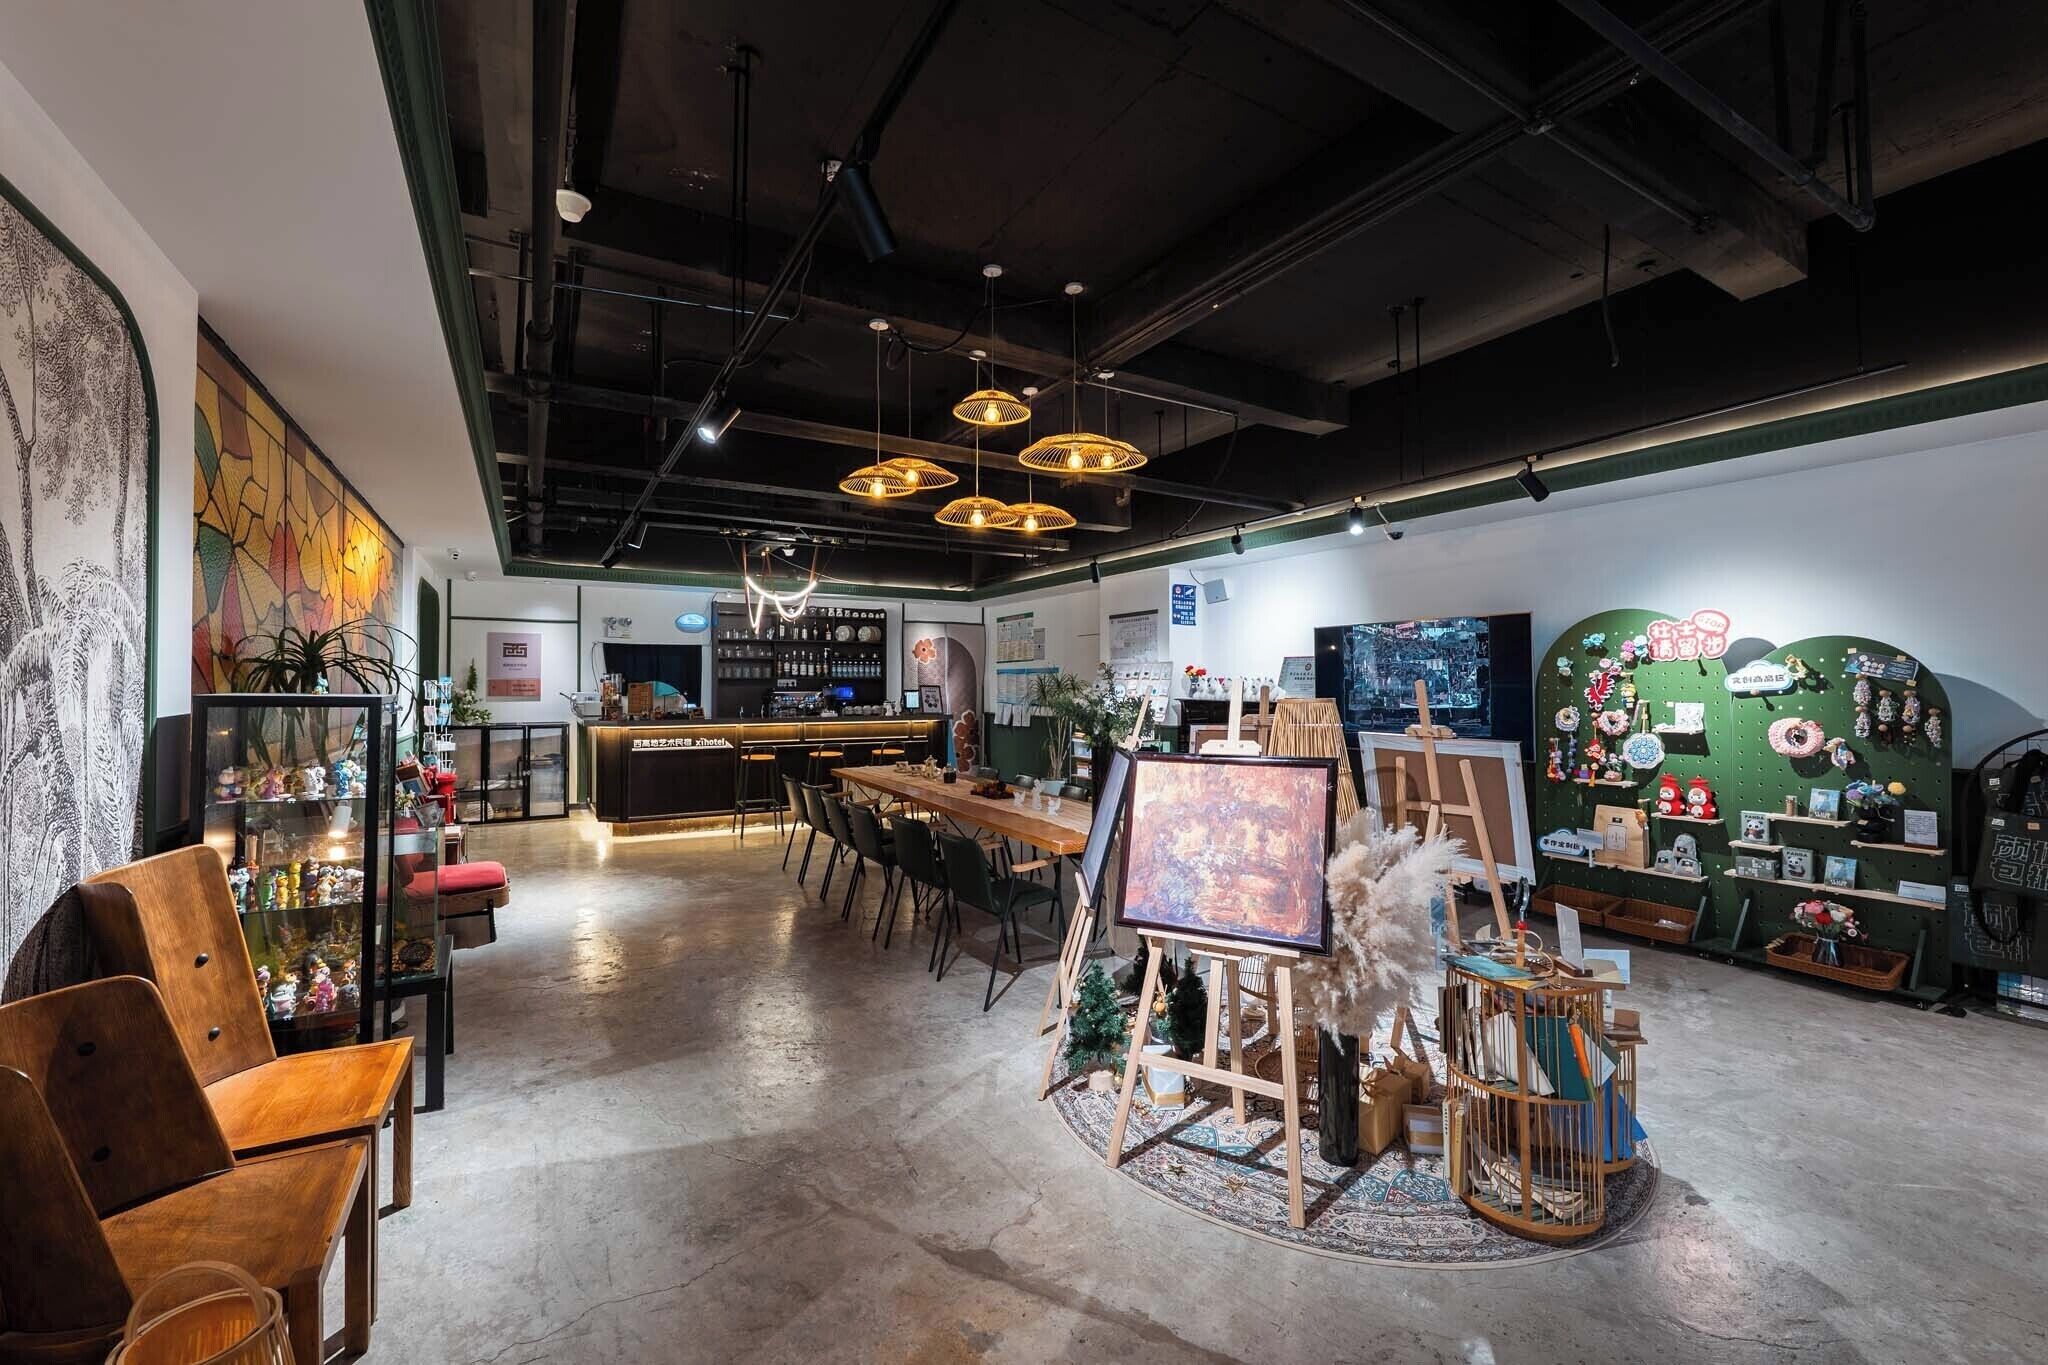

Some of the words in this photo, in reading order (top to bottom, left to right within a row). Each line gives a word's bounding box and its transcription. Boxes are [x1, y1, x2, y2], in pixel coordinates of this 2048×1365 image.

[1649, 620, 1698, 639] 壮士
[1650, 633, 1727, 659] 请留步
[1732, 674, 1785, 685] 文创商品区
[633, 738, 692, 748] 西高地艺术民宿
